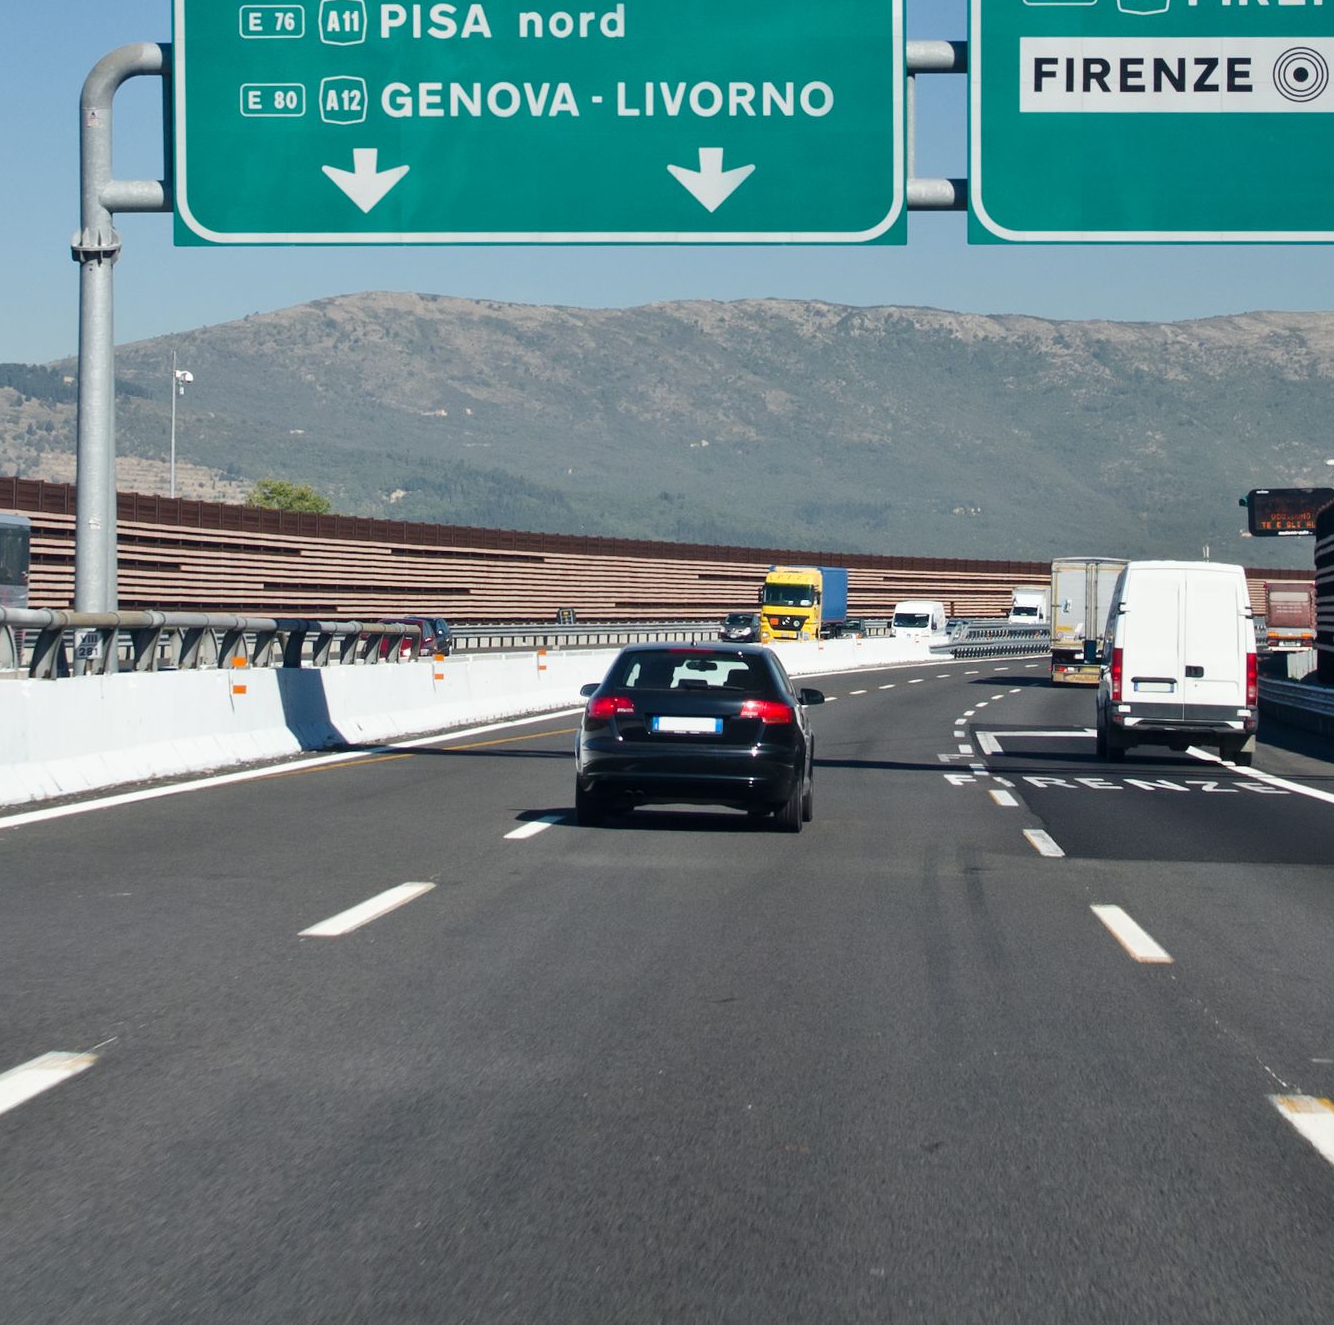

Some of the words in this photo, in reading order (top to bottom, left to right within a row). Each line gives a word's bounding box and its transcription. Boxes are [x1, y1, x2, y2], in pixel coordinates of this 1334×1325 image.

[249, 13, 262, 31] E
[275, 13, 295, 30] 76
[327, 11, 359, 31] A11
[381, 3, 491, 39] PISA
[519, 4, 624, 38] nord
[1034, 58, 1253, 92] FIRENZE
[248, 91, 262, 109] E
[274, 91, 297, 109] 80
[326, 90, 361, 110] A12
[381, 82, 579, 117] GENOVA
[618, 81, 833, 117] LIVORNO
[78, 647, 98, 656] 281
[943, 774, 1291, 794] FIRENZE
